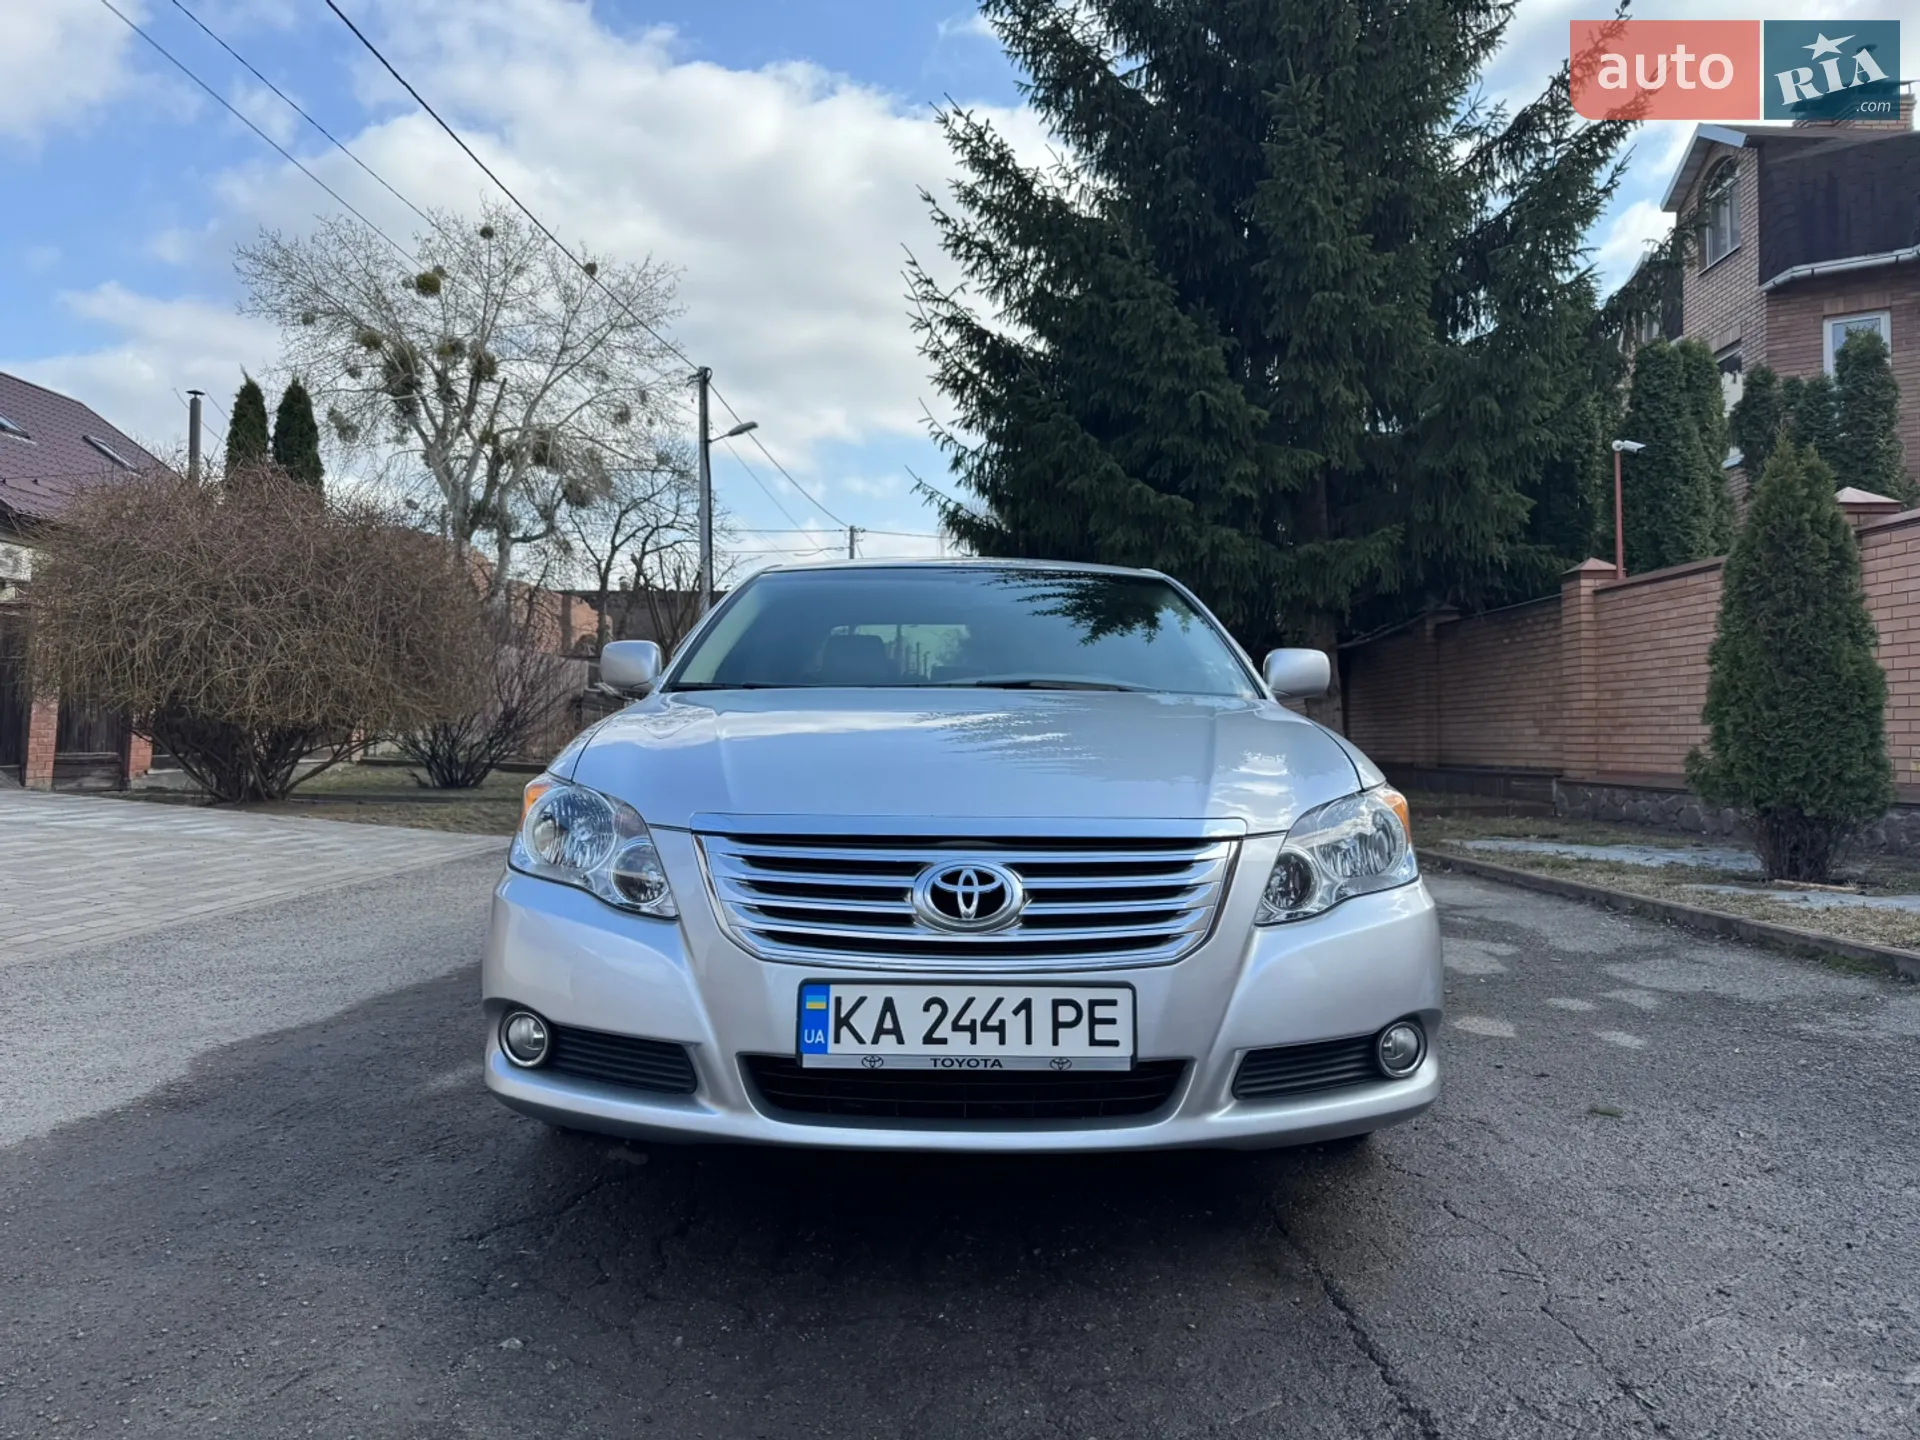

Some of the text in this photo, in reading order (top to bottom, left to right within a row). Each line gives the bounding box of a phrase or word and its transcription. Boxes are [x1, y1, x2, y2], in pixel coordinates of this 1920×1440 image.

[833, 995, 1120, 1047] KA 2441 PE
[804, 1028, 825, 1044] UA
[930, 1057, 1003, 1069] TOYOTA
